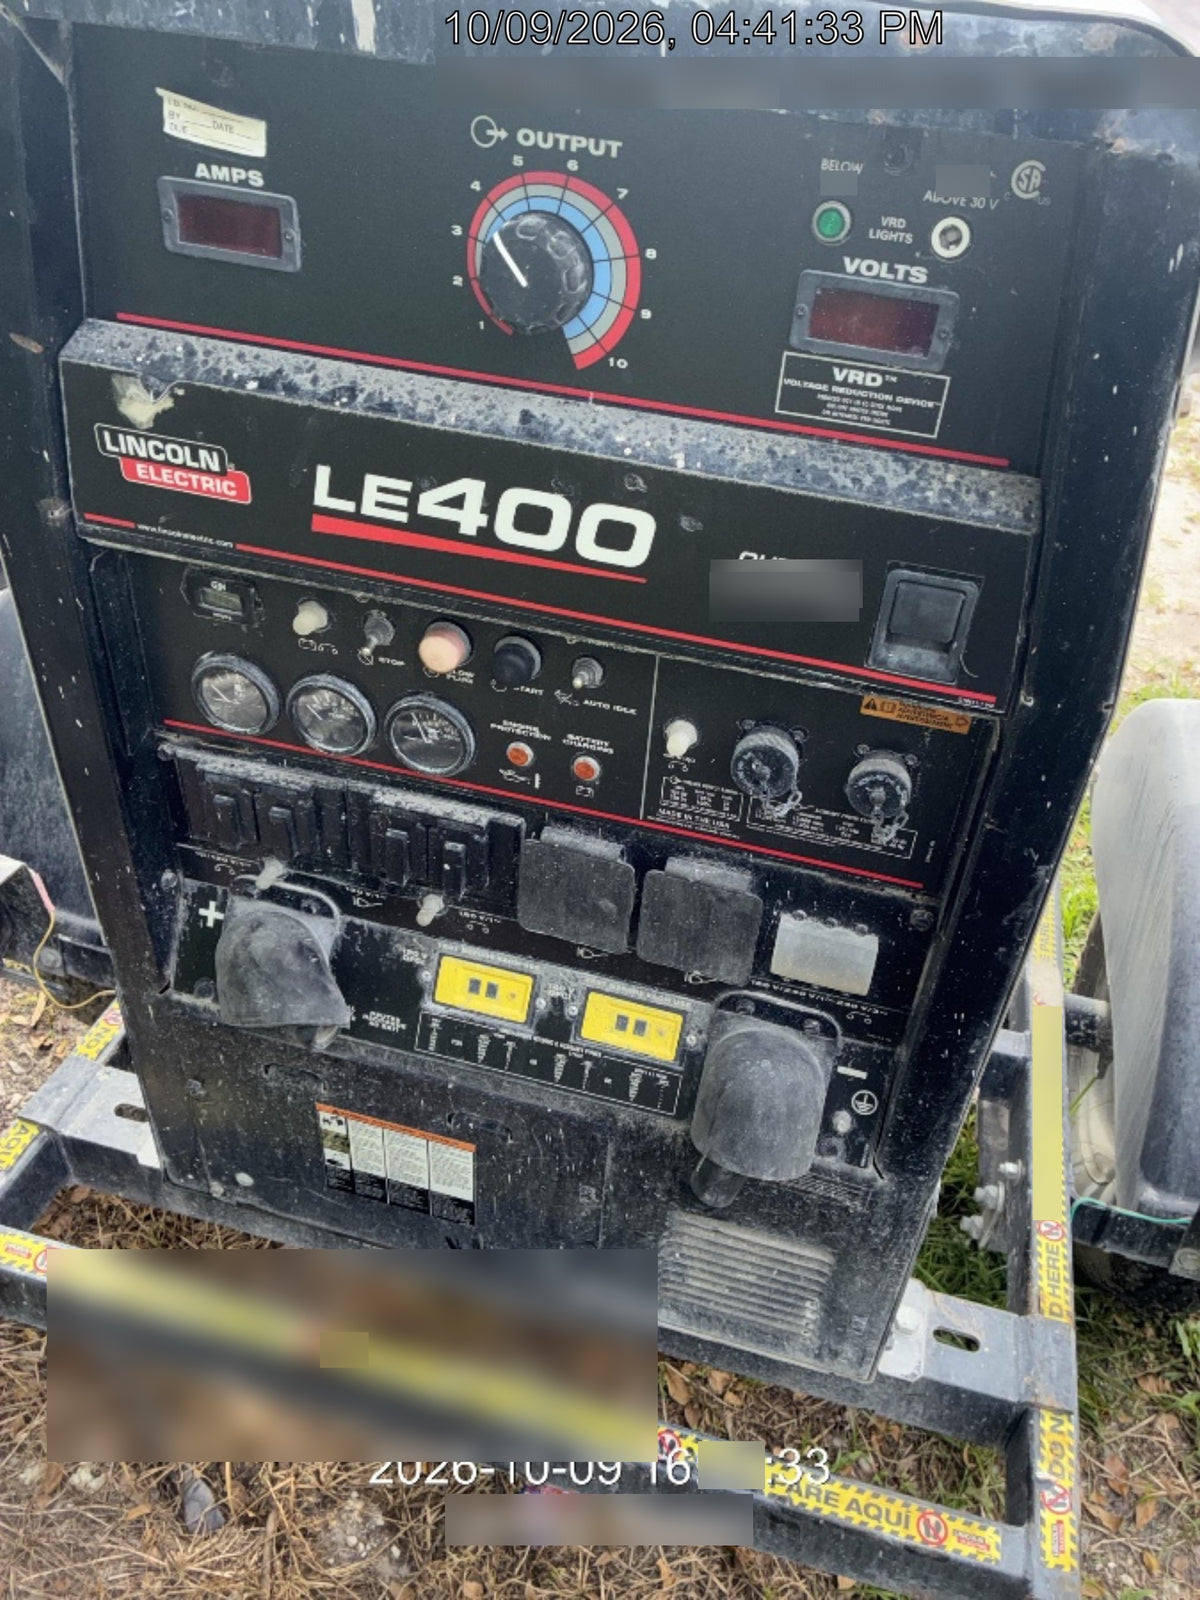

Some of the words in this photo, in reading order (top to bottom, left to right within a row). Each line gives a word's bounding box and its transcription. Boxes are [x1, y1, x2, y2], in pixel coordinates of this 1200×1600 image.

[212, 120, 234, 134] DATE
[516, 128, 623, 158] OUTPUT
[512, 155, 524, 167] 5
[567, 160, 579, 171] 6
[195, 162, 264, 188] AMPS
[470, 180, 481, 191] 4
[616, 188, 629, 199] 7
[970, 196, 986, 209] 30
[990, 198, 999, 210] V
[881, 216, 906, 229] VRD
[451, 226, 463, 236] 3
[869, 228, 913, 244] LIGHTS
[645, 248, 657, 260] 8
[843, 256, 928, 284] VOLTS
[453, 276, 463, 286] 2
[641, 309, 652, 320] 9
[479, 321, 485, 330] 1
[609, 357, 629, 369] 10
[103, 430, 221, 472] LINCOLN
[136, 463, 237, 496] ELECTRIC
[313, 463, 657, 568] LE400
[582, 699, 610, 710] AUTO
[1046, 1241, 1061, 1299] HERE
[1049, 1440, 1066, 1479] DO
